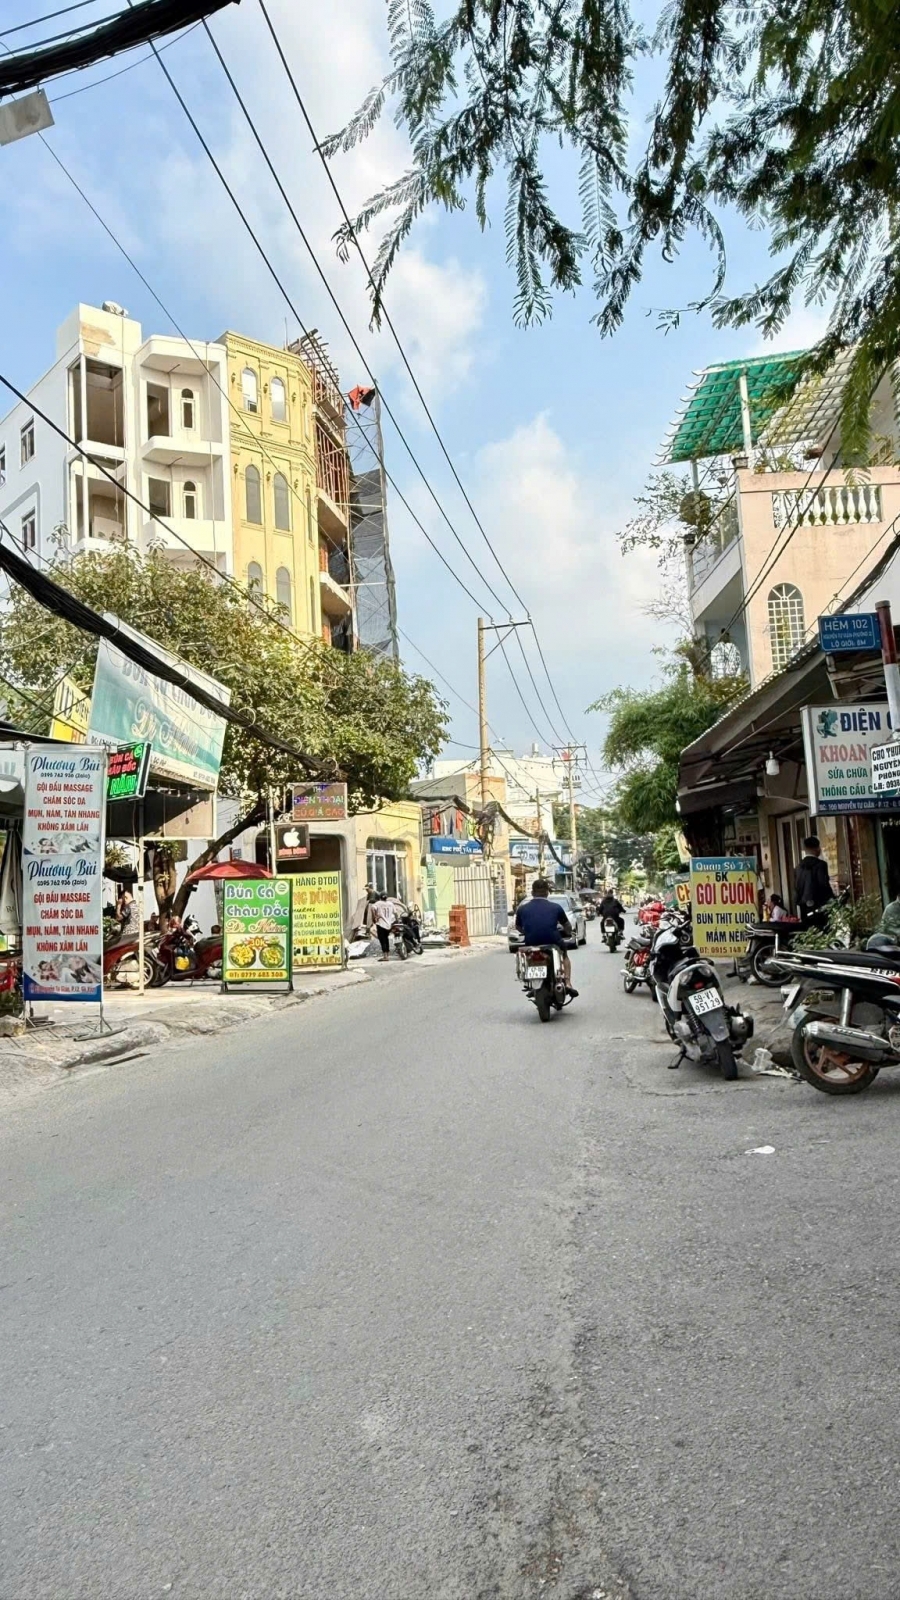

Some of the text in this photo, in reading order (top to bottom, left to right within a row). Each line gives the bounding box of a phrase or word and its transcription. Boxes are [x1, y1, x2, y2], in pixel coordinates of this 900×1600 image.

[852, 619, 868, 630] 102
[840, 707, 882, 736] ĐIỆN
[819, 743, 868, 763] KHOAN
[872, 748, 885, 761] CHO
[31, 755, 100, 773] Phương Bùi
[63, 783, 93, 792] MASSAGE
[821, 785, 848, 797] THÔNG
[78, 811, 100, 819] NHANG
[28, 859, 97, 881] Phương Bùi
[715, 872, 729, 882] 6K
[225, 881, 276, 900] Bún Cá
[696, 874, 755, 905] GỎI CUỐN
[60, 893, 91, 903] MASSAGE
[225, 900, 290, 918] Châu Đốc
[715, 912, 732, 926] THỊT
[77, 925, 99, 936] NHANG
[710, 946, 728, 954] 0915
[694, 997, 721, 1013] 951.29
